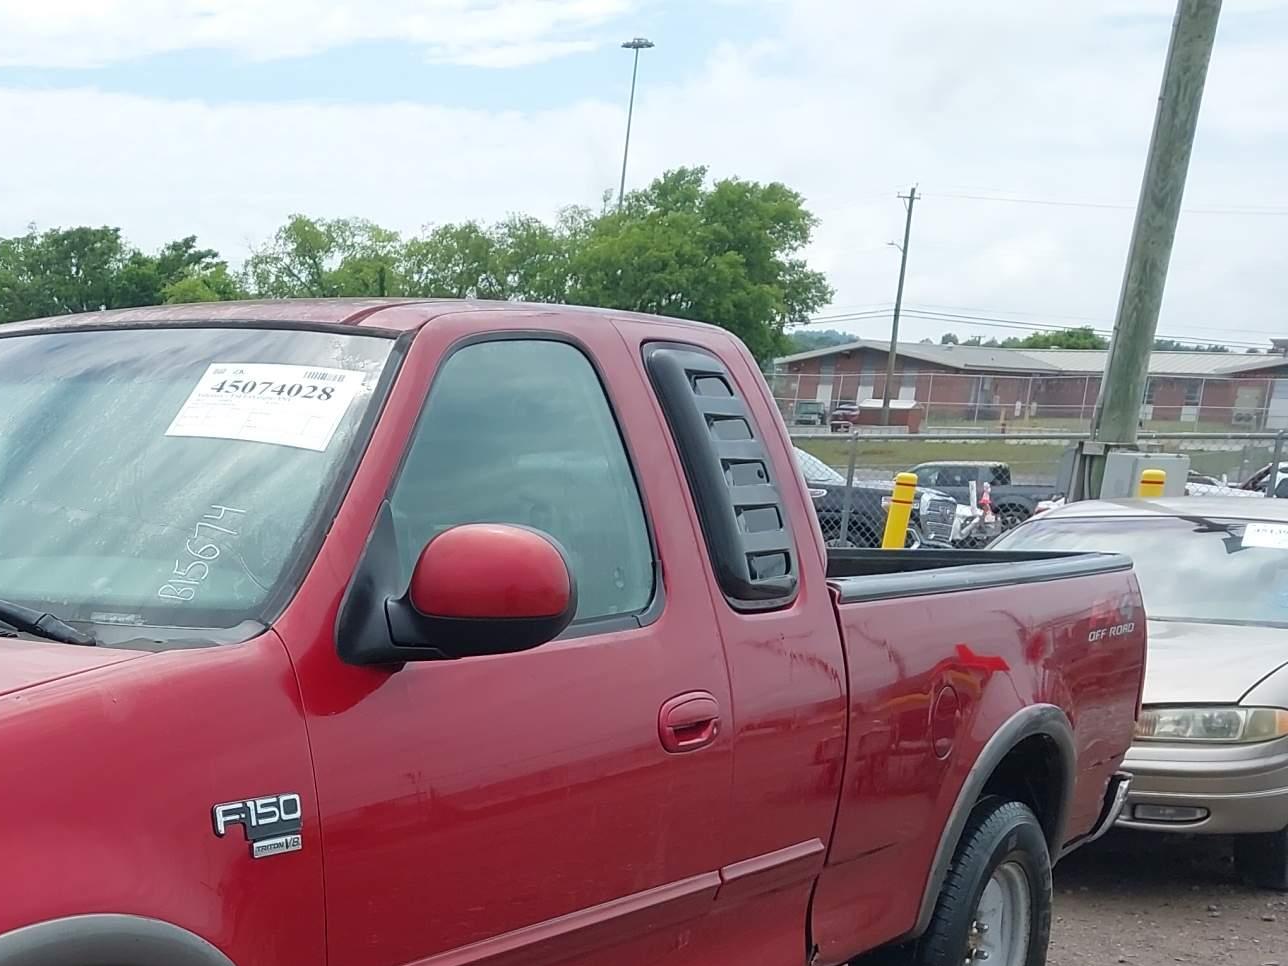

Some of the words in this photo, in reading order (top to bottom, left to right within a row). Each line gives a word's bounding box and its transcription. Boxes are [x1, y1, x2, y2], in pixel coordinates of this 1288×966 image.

[210, 379, 336, 401] 45074028
[158, 505, 247, 600] B15674
[1088, 629, 1108, 642] OFF
[1109, 622, 1136, 637] ROAD
[215, 793, 302, 835] F-150
[255, 841, 284, 853] TRITON
[285, 837, 300, 849] V8
